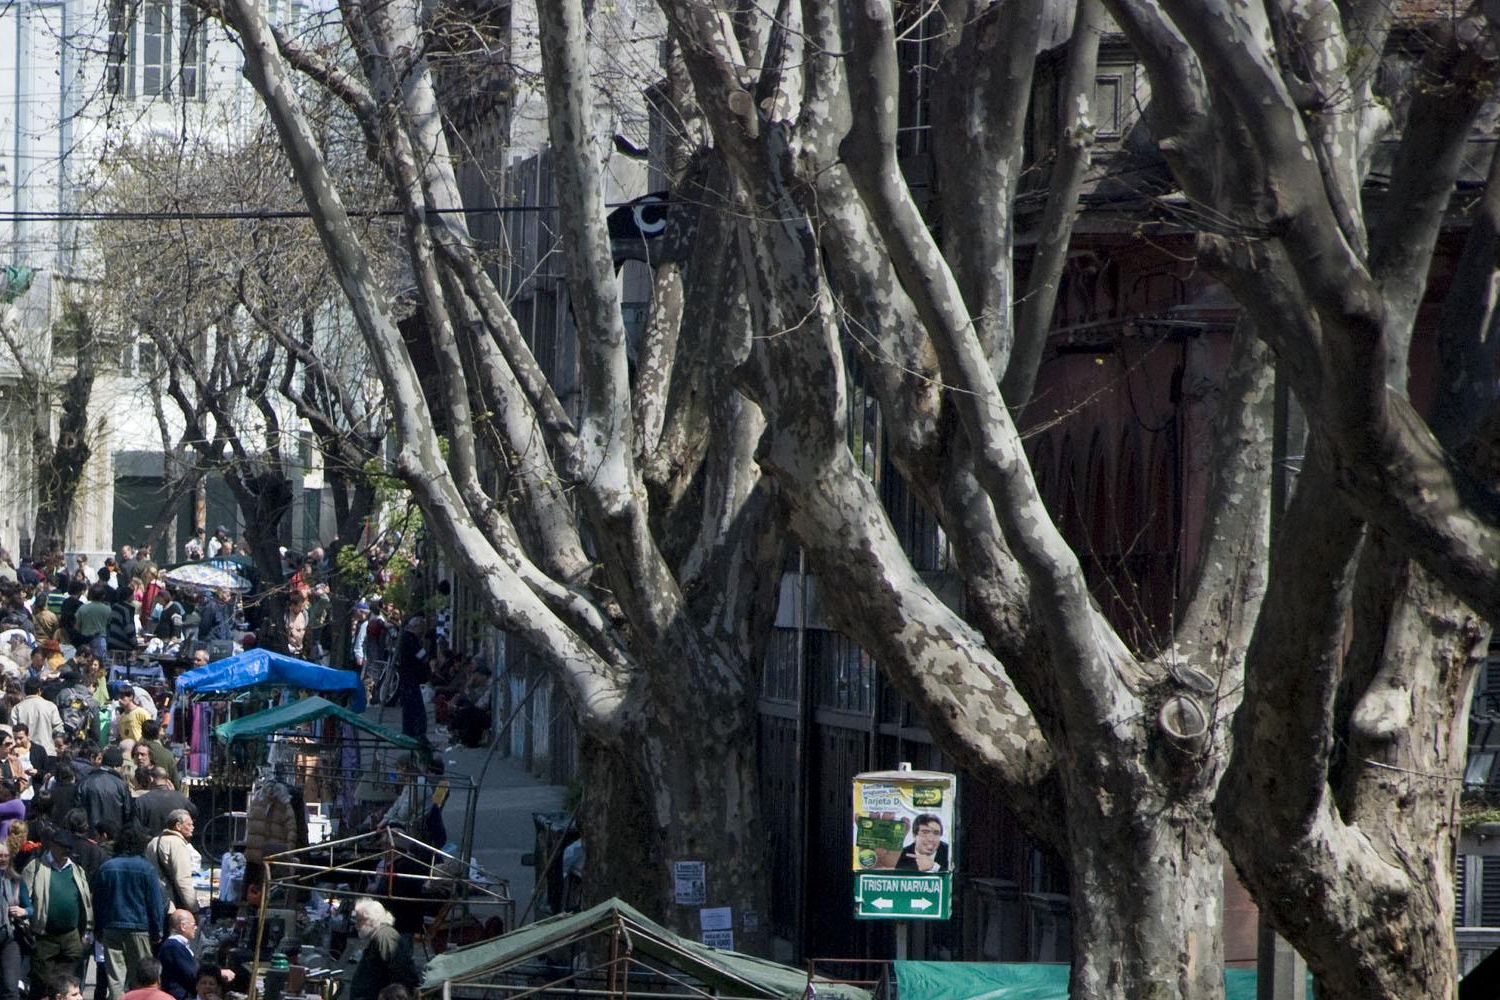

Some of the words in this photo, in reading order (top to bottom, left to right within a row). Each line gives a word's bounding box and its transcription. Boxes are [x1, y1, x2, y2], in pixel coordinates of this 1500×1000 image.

[863, 797, 891, 806] Tarjeta
[863, 879, 899, 892] TRISTAN
[901, 881, 940, 893] NARVAJA
